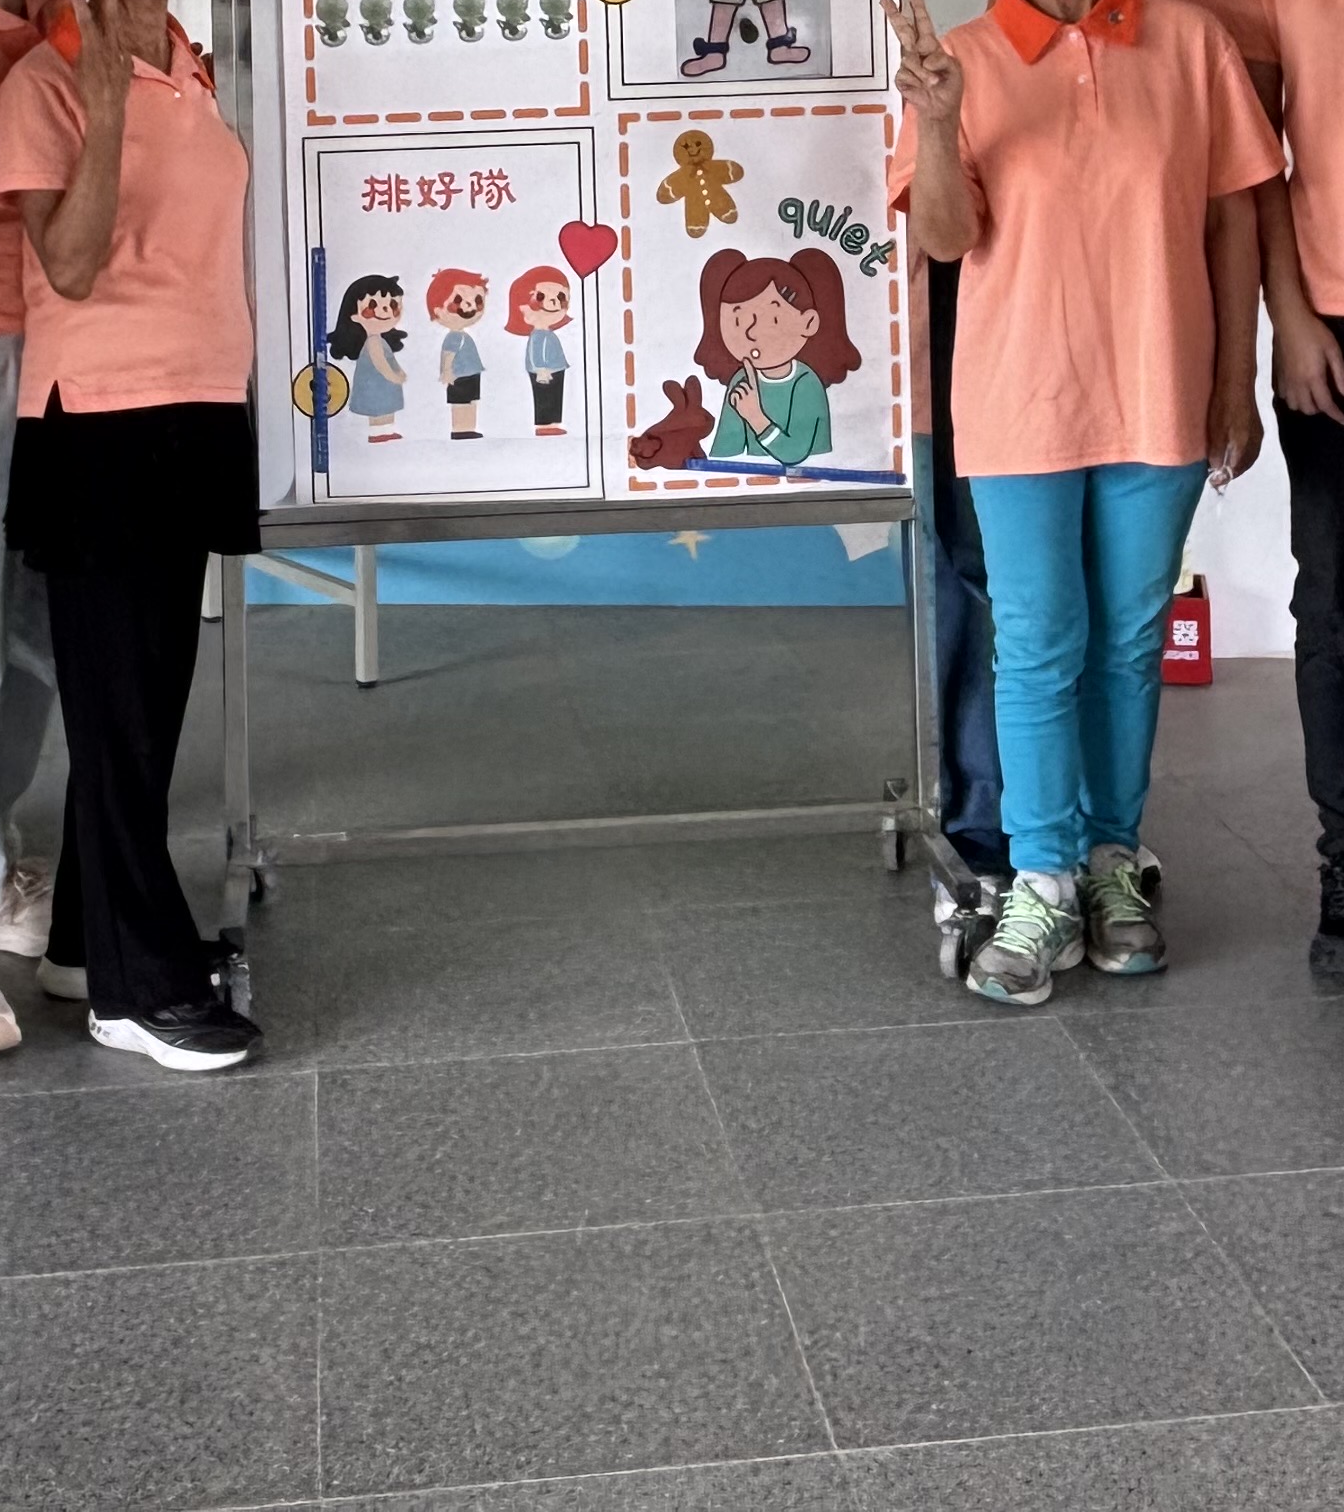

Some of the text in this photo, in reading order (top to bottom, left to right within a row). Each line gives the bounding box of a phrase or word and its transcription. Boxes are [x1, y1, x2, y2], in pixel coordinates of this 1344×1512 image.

[361, 167, 517, 213] 排好隊
[777, 197, 897, 278] quiet
